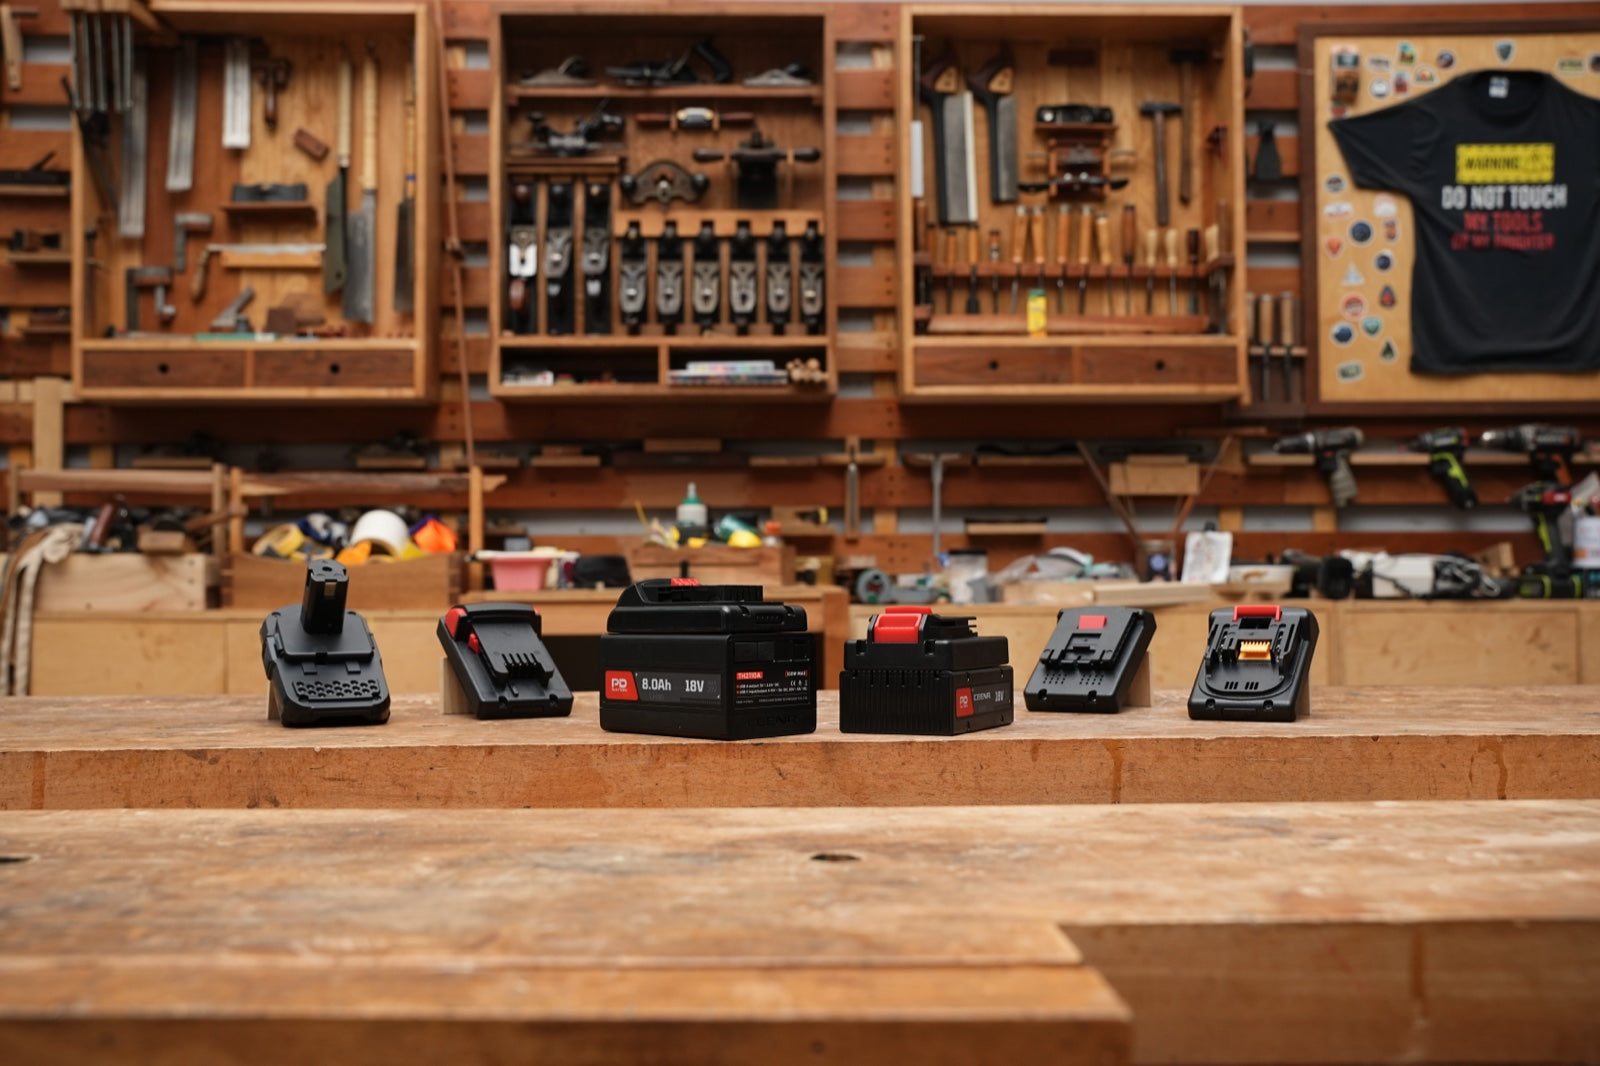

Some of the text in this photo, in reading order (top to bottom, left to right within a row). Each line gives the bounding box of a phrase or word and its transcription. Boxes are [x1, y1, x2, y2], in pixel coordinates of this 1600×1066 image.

[1465, 157, 1519, 170] WARNING
[1441, 184, 1567, 210] DO NOT TOUCH
[1464, 210, 1544, 232] MY TOOLS
[611, 678, 628, 688] PD
[641, 678, 705, 693] 8.0Ah 18V
